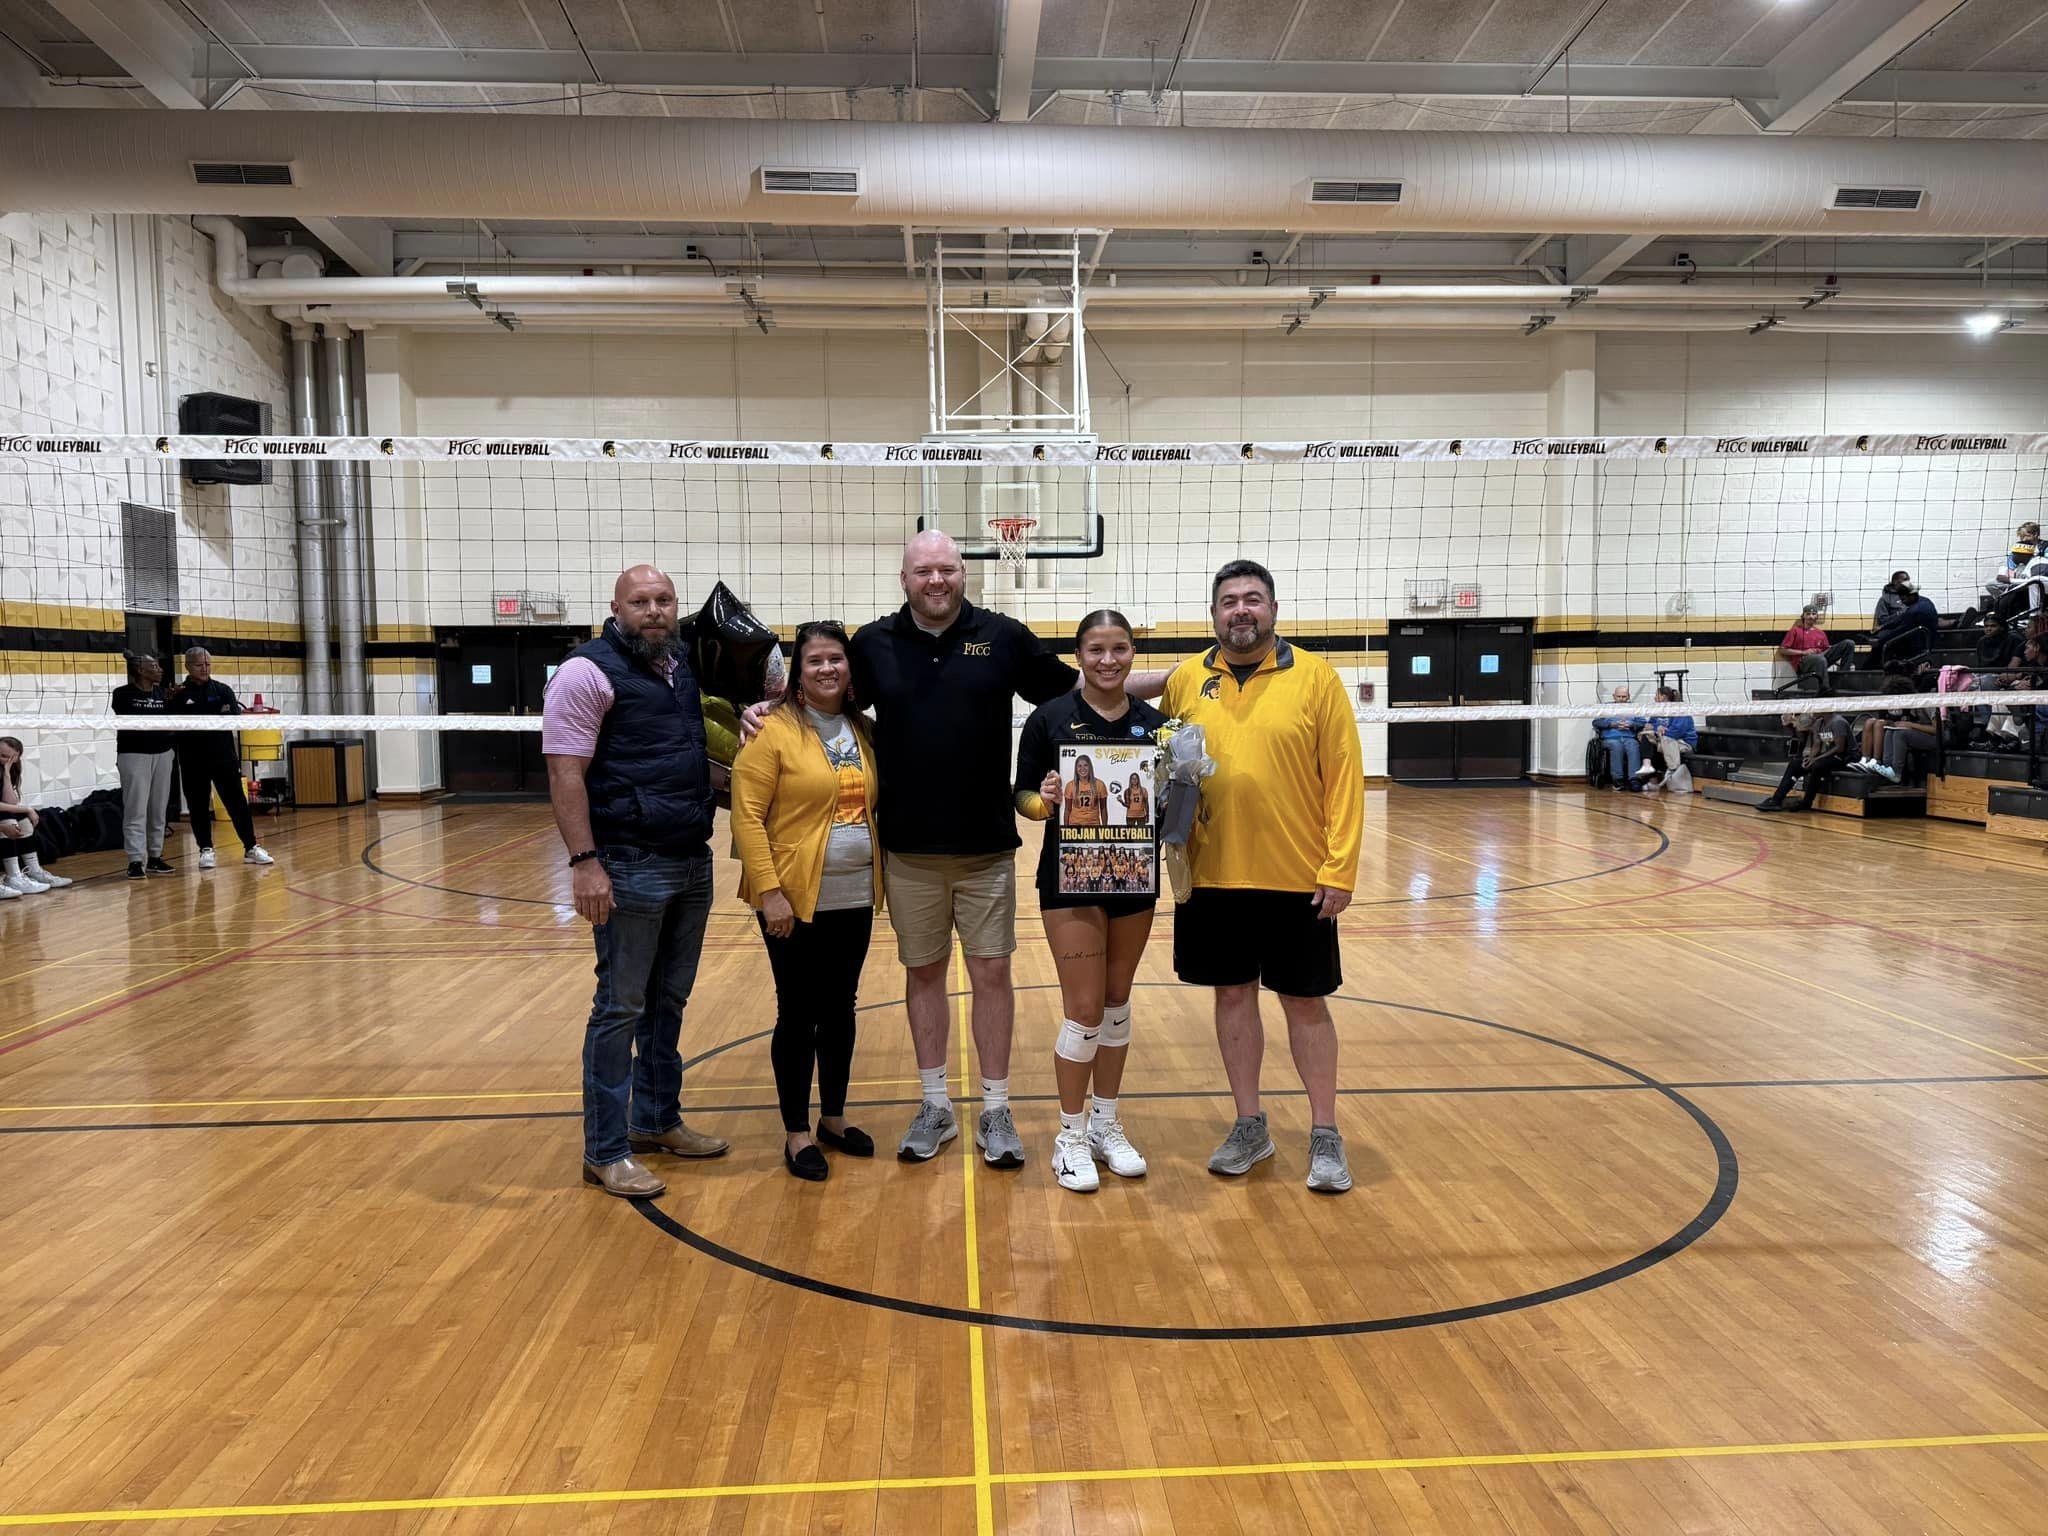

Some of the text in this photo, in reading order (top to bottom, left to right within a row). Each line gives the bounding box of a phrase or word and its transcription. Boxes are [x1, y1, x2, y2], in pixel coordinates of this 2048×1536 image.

[0, 434, 102, 453] FTCC VOLLEYBALL
[224, 436, 328, 454] FTCC VOLLEYBALL
[447, 438, 550, 456] FTCC VOLLEYBALL
[668, 440, 769, 458] FTCC VOLLEYBALL
[1303, 441, 1399, 458] FTCC VOLLEYBALL
[1511, 438, 1606, 455] FTCC VOLLEYBALL
[1715, 436, 1808, 453] FTCC VOLLEYBALL
[1914, 433, 2007, 450] FTCC VOLLEYBALL
[885, 444, 983, 461] FTCC VOLLEYBALL
[1094, 444, 1191, 461] FTCC VOLLEYBALL
[498, 599, 520, 613] EXIT
[1457, 592, 1477, 607] EXIT
[963, 641, 992, 656] FTCC
[1061, 748, 1141, 759] #12 SYDNEY
[1080, 796, 1091, 807] 12
[1060, 827, 1153, 840] TROJAN VOLLEYBALL
